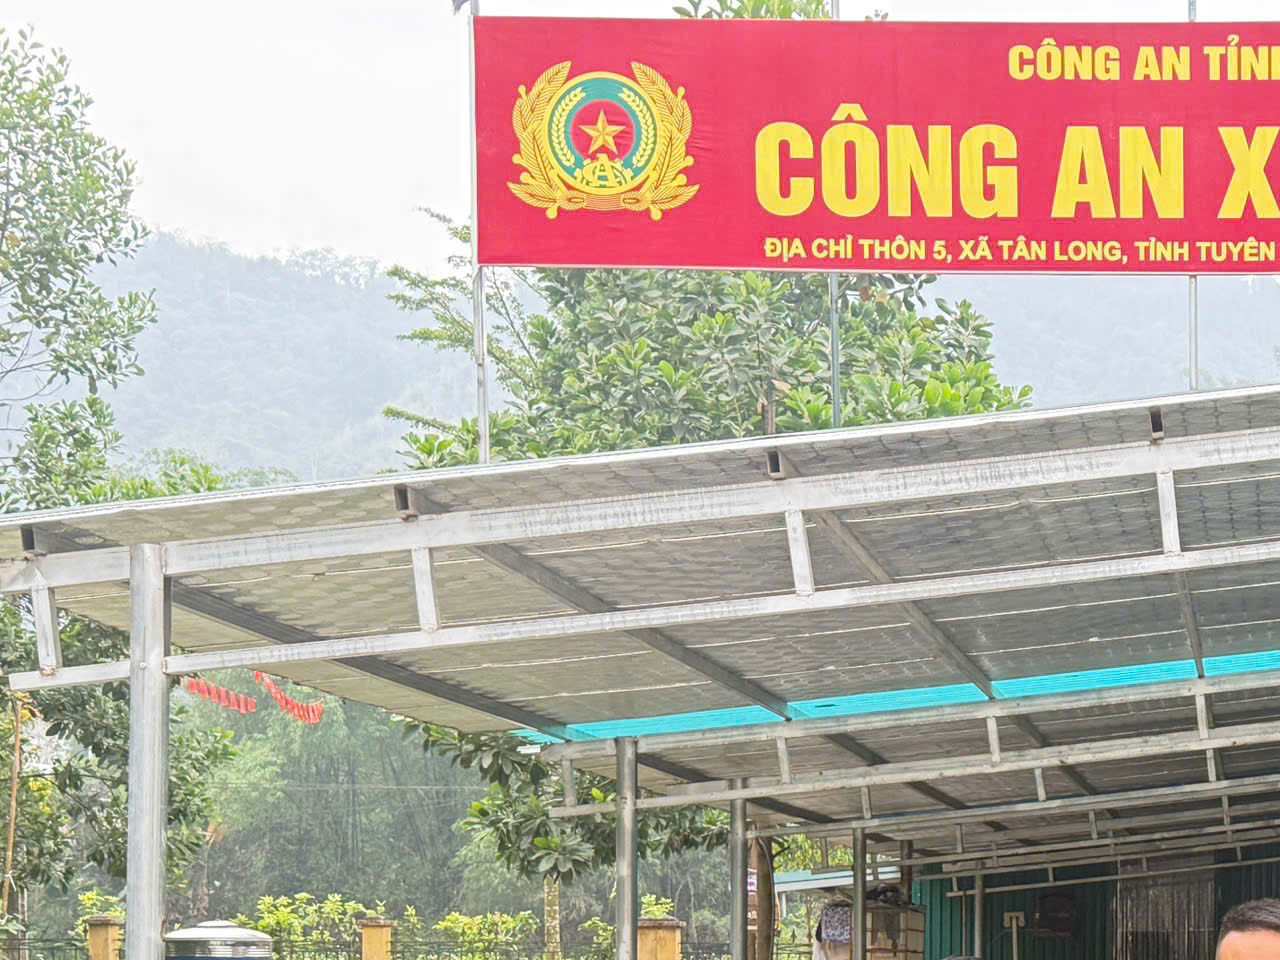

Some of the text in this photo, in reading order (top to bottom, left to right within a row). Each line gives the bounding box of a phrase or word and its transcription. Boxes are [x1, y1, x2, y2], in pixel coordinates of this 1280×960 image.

[1008, 38, 1121, 82] CÔNG
[1133, 45, 1191, 81] AN
[755, 104, 1019, 219] CÔNG
[1050, 126, 1185, 219] AN
[763, 238, 807, 263] ĐỊA
[811, 236, 854, 261] CHỈ
[858, 236, 926, 261] THÔN
[932, 240, 953, 263] 5,
[959, 235, 993, 261] XÃ
[999, 236, 1047, 262] TÂN
[1053, 240, 1128, 265] LONG,
[1135, 236, 1190, 262] TỈNH
[1196, 237, 1276, 262] TUYÊN
